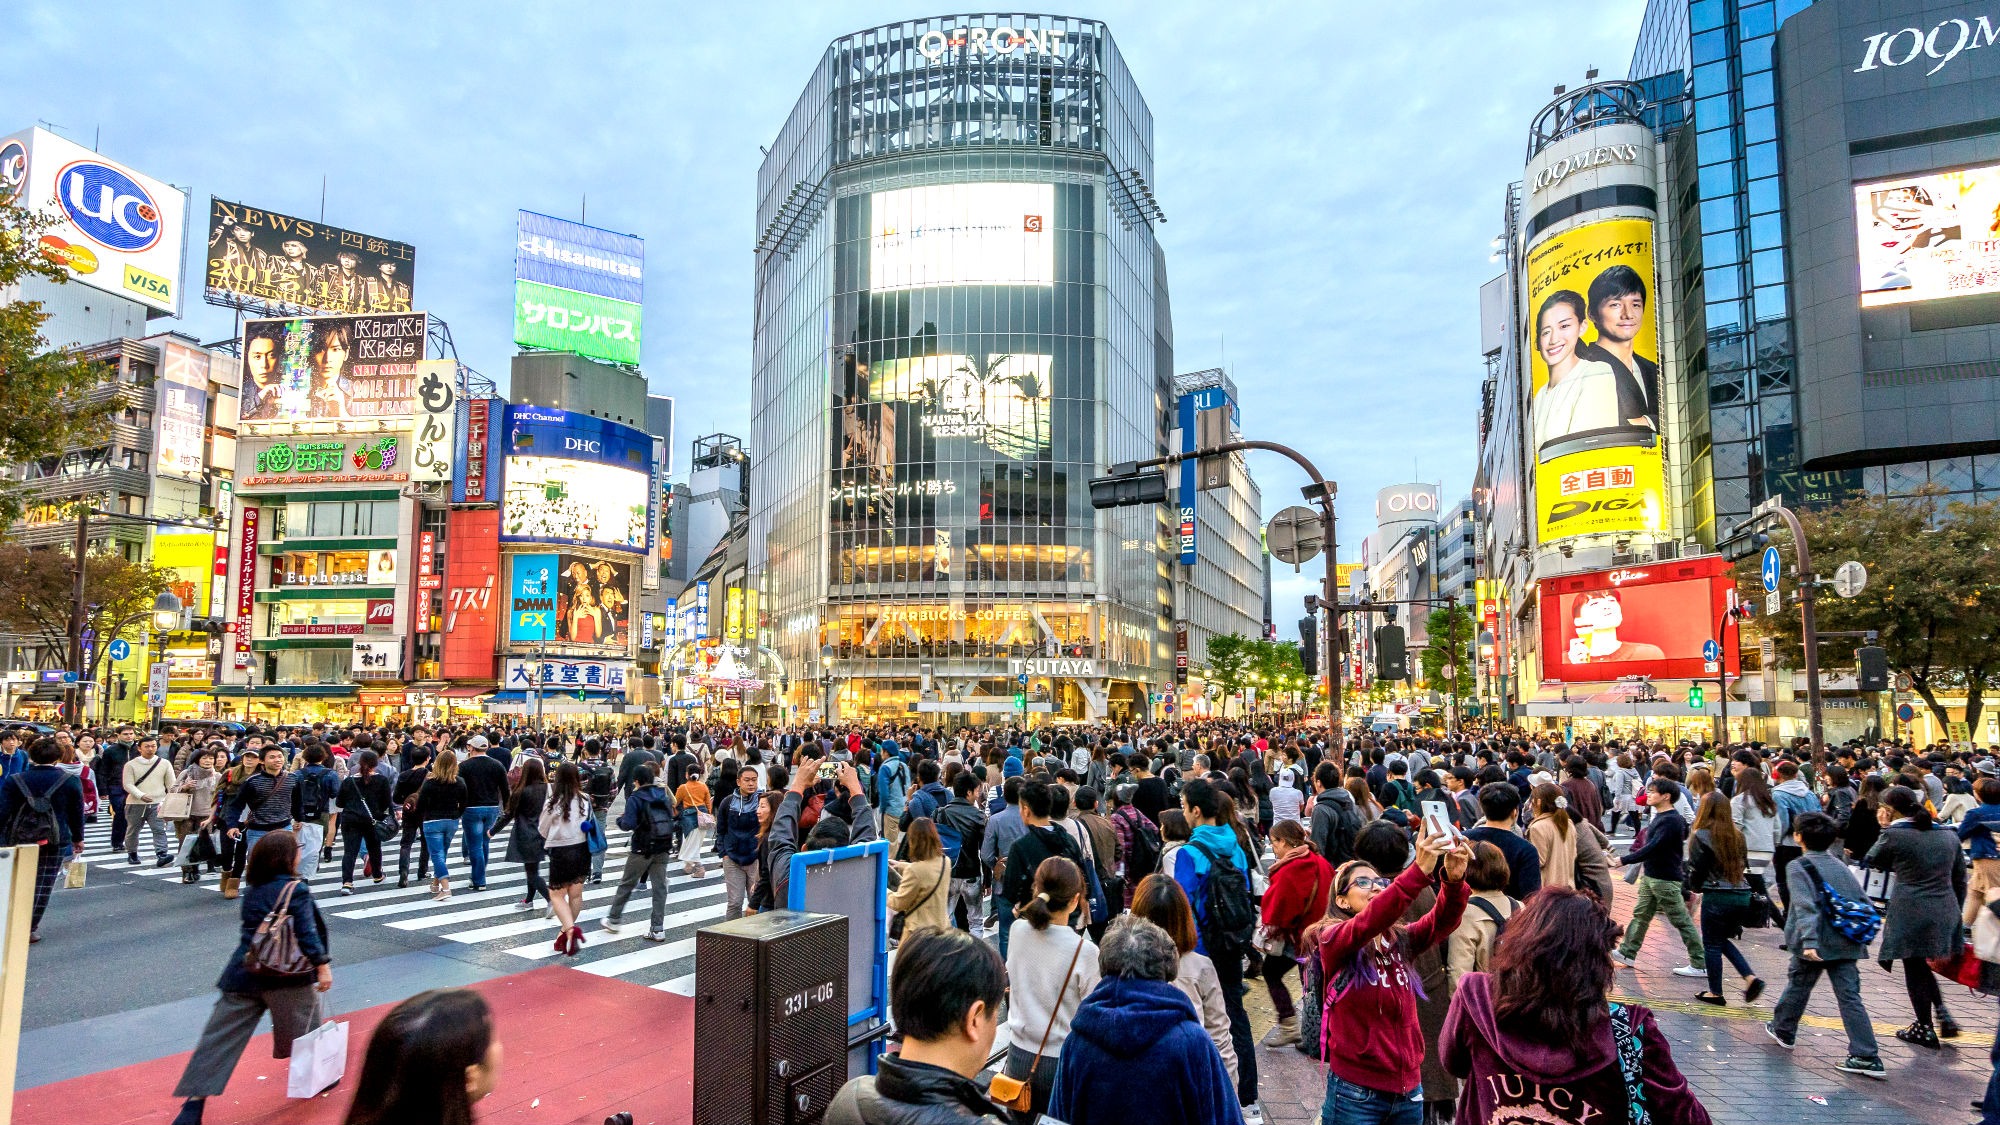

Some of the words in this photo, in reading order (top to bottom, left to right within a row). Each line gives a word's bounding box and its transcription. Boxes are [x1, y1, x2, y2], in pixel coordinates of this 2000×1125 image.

[919, 26, 1065, 64] QFRONT
[213, 201, 314, 238] NEWS
[341, 231, 412, 261] 四銃士
[1530, 241, 1564, 264] Panasonic
[129, 273, 170, 297] VISA
[354, 317, 423, 339] KinKi
[522, 300, 635, 342] サロンパス
[359, 338, 415, 359] Kids
[353, 365, 378, 377] NEW
[414, 372, 454, 478] もんじゃ
[513, 412, 532, 420] DHC
[532, 412, 565, 423] Channel
[465, 402, 485, 497] 三千里薬品
[564, 437, 601, 454] DHC
[295, 451, 343, 471] 西村
[1562, 468, 1634, 493] 全自動
[1180, 507, 1194, 555] SEIBU
[286, 570, 366, 586] Euphoria
[1609, 571, 1649, 586] Glico
[368, 602, 394, 620] JTB
[446, 574, 495, 633] クスリ
[514, 597, 554, 612] DMM
[519, 612, 547, 627] FX
[882, 609, 967, 622] STARBUCKS
[975, 610, 1029, 621] COFFEE
[511, 663, 624, 686] 大盛堂書店
[1011, 659, 1093, 676] TSUTAYA
[784, 981, 834, 1016] 331-06
[1486, 1073, 1603, 1125] JUICY
